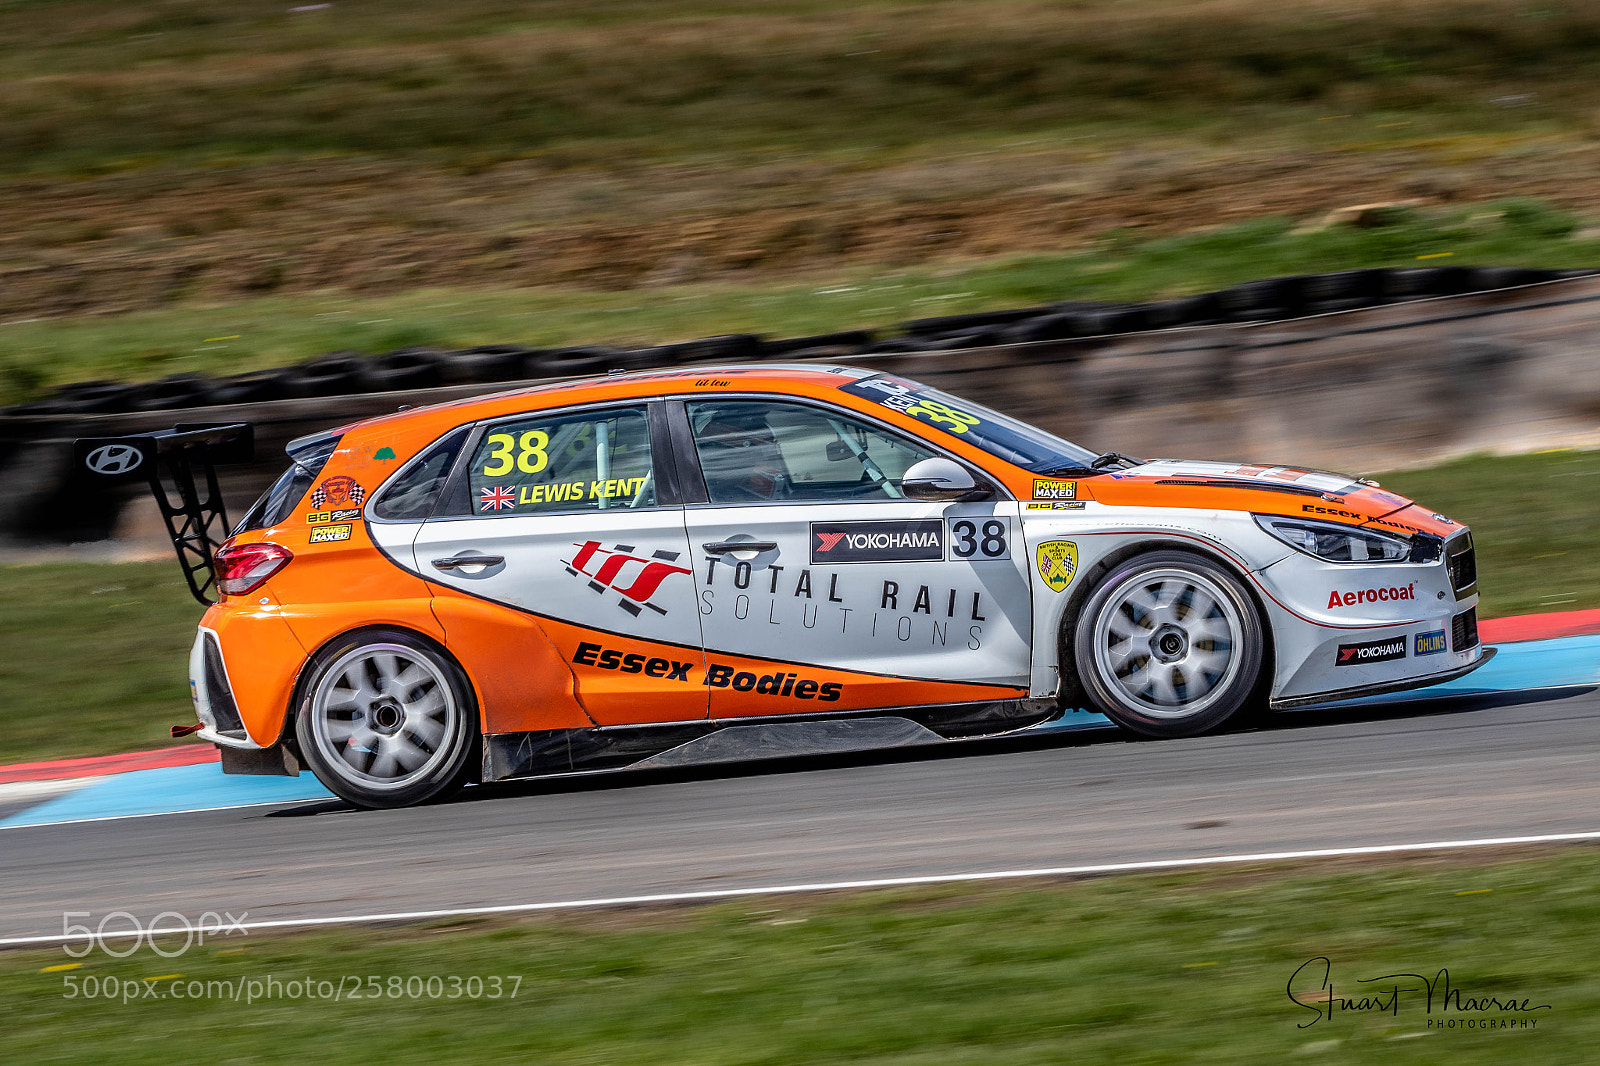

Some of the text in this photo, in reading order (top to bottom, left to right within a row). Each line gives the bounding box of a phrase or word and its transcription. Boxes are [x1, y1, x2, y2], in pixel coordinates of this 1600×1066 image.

[905, 400, 981, 434] 38
[483, 430, 550, 477] 38
[519, 476, 647, 505] LEWIS KENT
[1035, 488, 1074, 499] MAXED
[1036, 481, 1073, 490] POWER
[1302, 505, 1361, 520] Essex
[314, 526, 349, 535] POWER
[846, 531, 940, 549] YOKOHAMA
[952, 520, 1006, 557] 38
[705, 556, 986, 622] TOTAL RAIL
[701, 590, 982, 651] SOLUTIONS
[1356, 642, 1404, 659] YOKOHAMA
[1417, 635, 1445, 652] ÖHLINS
[572, 642, 843, 702] Essex Bodies
